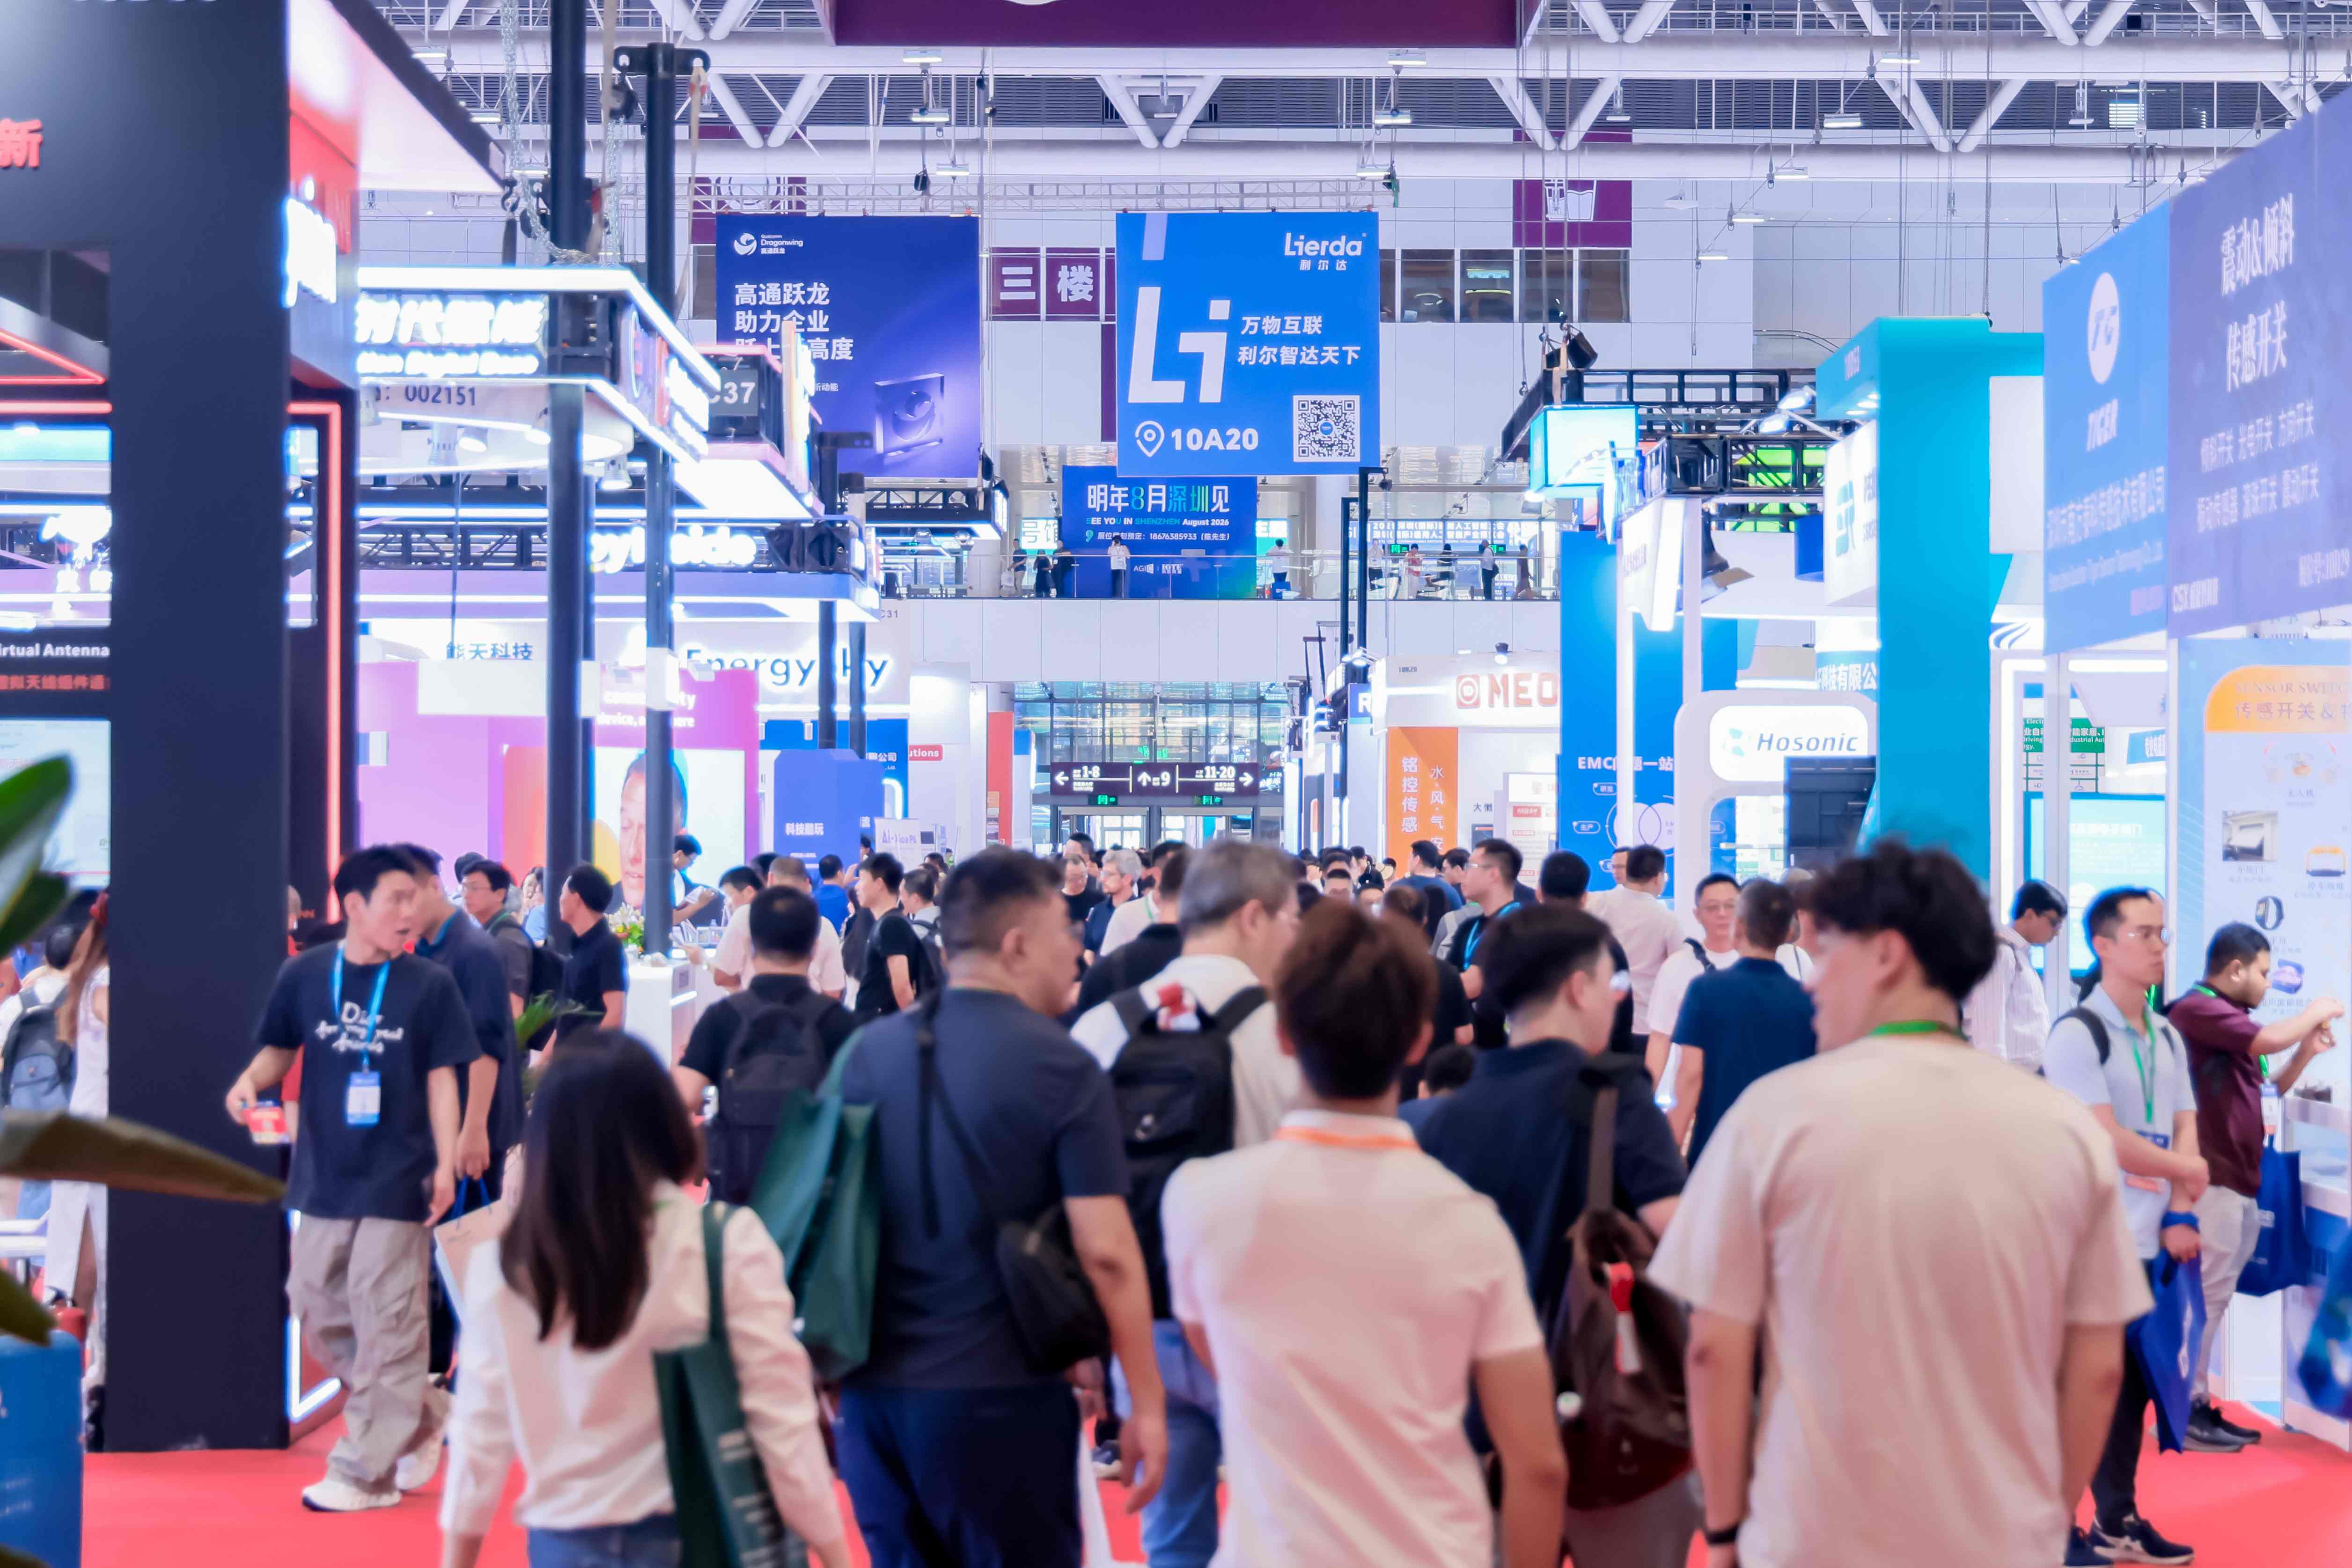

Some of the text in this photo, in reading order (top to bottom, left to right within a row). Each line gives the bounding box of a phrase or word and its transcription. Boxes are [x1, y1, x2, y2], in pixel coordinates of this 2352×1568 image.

[1285, 233, 1362, 256] Lierda
[1300, 259, 1347, 271] 利尔达
[1000, 265, 1094, 302] 三楼
[735, 282, 830, 306] 高通跃龙
[735, 309, 830, 333] 助力企业
[1241, 315, 1323, 335] 万物互联
[1237, 345, 1361, 365] 利尔智达天下
[1171, 427, 1259, 450] 10A20
[1087, 484, 1230, 513] 明年8月深圳见
[1182, 518, 1209, 527] August
[43, 643, 110, 656] Antenna
[1757, 733, 1859, 751] Hosonic
[1082, 765, 1100, 778] 1-8
[1161, 771, 1170, 787] 9
[1205, 765, 1235, 778] 11-20
[1402, 757, 1419, 833] 铭控传感
